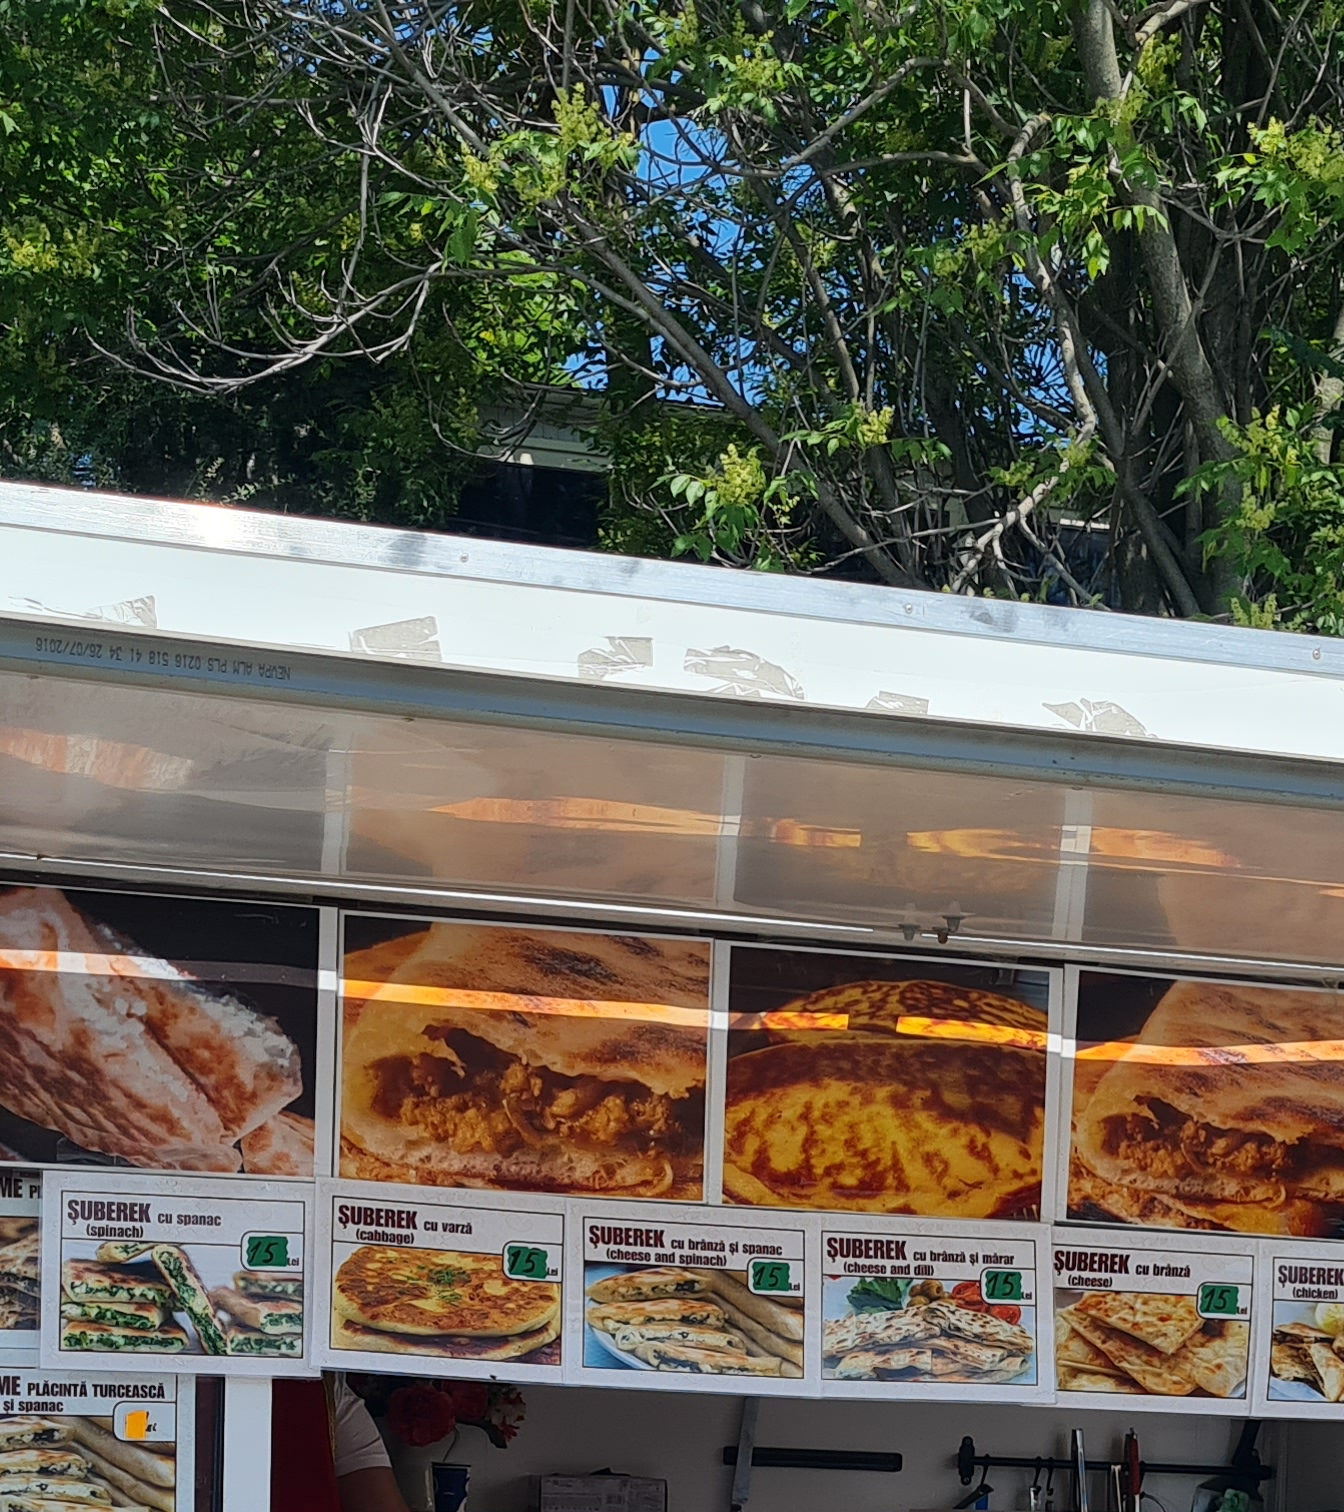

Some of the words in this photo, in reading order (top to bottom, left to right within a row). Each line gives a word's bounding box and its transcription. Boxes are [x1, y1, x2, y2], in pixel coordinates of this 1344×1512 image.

[35, 636, 103, 658] 26/07/2016
[109, 648, 123, 661] 34
[130, 648, 142, 663] 41
[148, 651, 169, 667] 518
[175, 654, 202, 670] 0216
[208, 657, 227, 672] PLS
[232, 660, 253, 676] ALM
[157, 1213, 173, 1225] cu
[177, 1214, 221, 1227] spanac
[424, 1221, 439, 1232] cu
[442, 1221, 472, 1235] varză
[86, 1224, 143, 1239] (spinach)
[356, 1228, 414, 1244] (cabbage)
[248, 1240, 279, 1264] 15
[671, 1239, 684, 1249] cu
[688, 1239, 725, 1252] brânză
[742, 1244, 782, 1256] spanac
[508, 1250, 540, 1274] 15
[606, 1248, 651, 1262] (cheese
[655, 1251, 675, 1264] and
[679, 1253, 727, 1267] spinach)
[913, 1252, 926, 1261] cu
[930, 1250, 965, 1263] brânză
[982, 1253, 1014, 1265] mărar
[756, 1265, 782, 1288] 15
[844, 1261, 886, 1275] (cheese
[890, 1264, 911, 1275] and
[914, 1263, 934, 1276] dill)
[1136, 1265, 1149, 1275] cu
[1153, 1264, 1191, 1278] brânză
[988, 1273, 1015, 1297] 15
[1068, 1275, 1113, 1288] (cheese)
[1205, 1289, 1231, 1311] 15
[1293, 1287, 1338, 1299] (chicken)
[27, 1380, 88, 1399] PLĂCINTĂ
[92, 1382, 165, 1399] TURCEASCĂ
[18, 1401, 63, 1413] spanac
